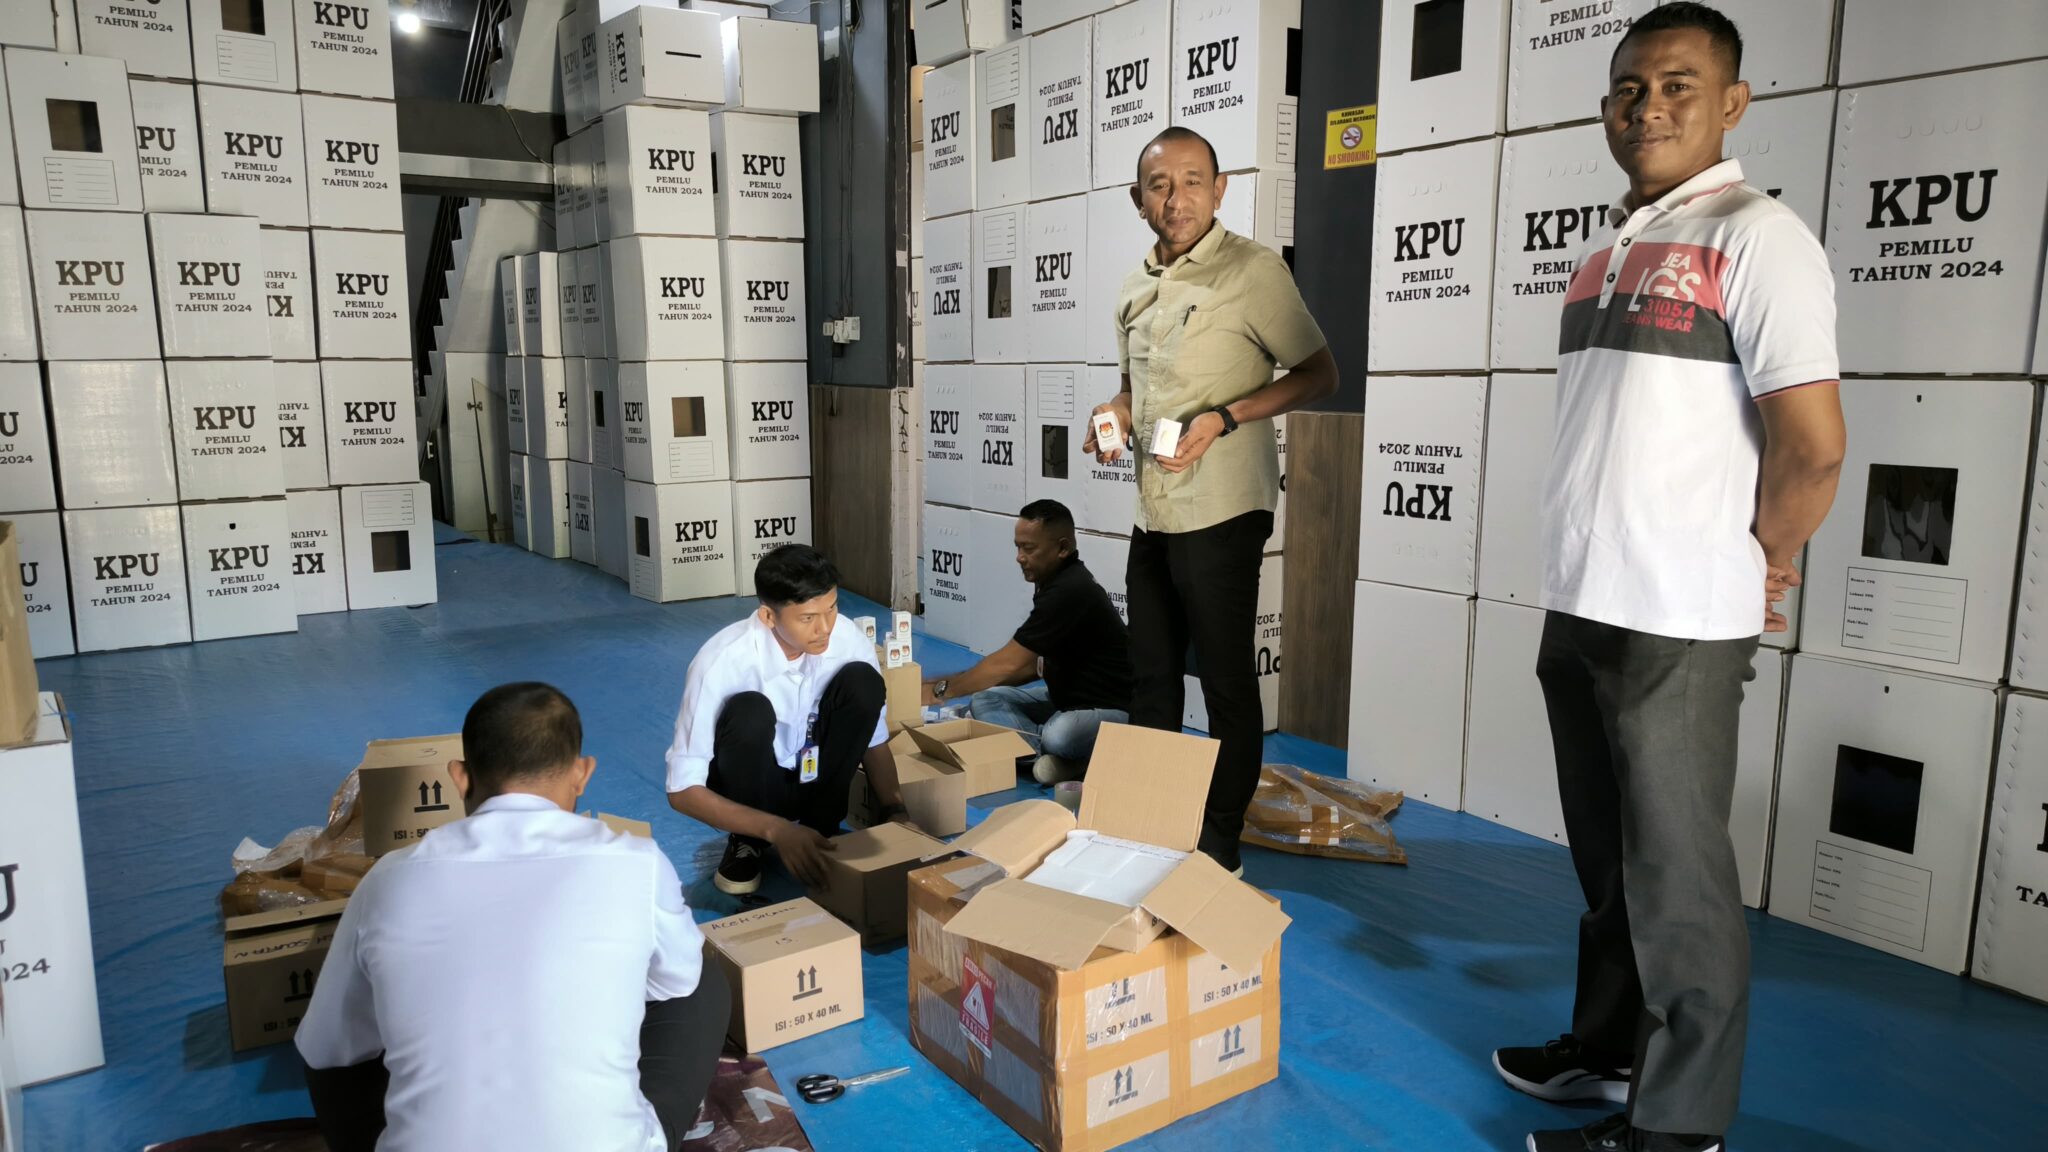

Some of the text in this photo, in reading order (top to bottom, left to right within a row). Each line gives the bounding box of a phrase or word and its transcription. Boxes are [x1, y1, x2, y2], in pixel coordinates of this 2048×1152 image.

[109, 6, 156, 19] PEMILU
[313, 1, 369, 30] KPU
[1550, 1, 1613, 26] PEMILU
[95, 16, 173, 32] TAHUN 2024
[323, 31, 363, 43] PEMILU
[1530, 16, 1633, 50] TAHUN 2024
[311, 40, 378, 55] TAHUN 2024
[614, 32, 628, 83] KPU
[1187, 36, 1239, 80] KPU
[1039, 76, 1082, 96] TAHUN 2024
[1106, 58, 1149, 99] KPU
[1193, 81, 1231, 99] PEMILU
[1047, 92, 1073, 108] PEMILU
[1111, 99, 1143, 116] PEMILU
[1182, 95, 1243, 117] TAHUN 2024
[931, 111, 960, 143] KPU
[1043, 108, 1078, 144] KPU
[1101, 112, 1154, 132] TAHUN 2024
[224, 132, 283, 159] KPU
[325, 140, 379, 165] KPU
[935, 144, 956, 157] PEMILU
[234, 162, 277, 172] PEMILU
[648, 148, 695, 172] KPU
[742, 154, 786, 177] KPU
[929, 155, 964, 171] TAHUN 2024
[1328, 154, 1337, 166] NO
[158, 168, 187, 177] 2024
[221, 171, 292, 184] TAHUN 2024
[334, 168, 374, 178] PEMILU
[656, 176, 691, 184] PEMILU
[322, 178, 388, 190] TAHUN 2024
[646, 186, 703, 195] TAHUN 2024
[749, 181, 781, 189] PEMILU
[739, 190, 792, 200] TAHUN 2024
[1866, 169, 1998, 229] KPU
[1394, 218, 1465, 262] KPU
[1879, 237, 1974, 257] PEMILU
[929, 262, 963, 274] TAHUN 2024
[1036, 252, 1072, 282] KPU
[1660, 252, 1691, 270] JEA
[55, 260, 124, 286] KPU
[177, 261, 241, 286] KPU
[1402, 268, 1454, 283] PEMILU
[1849, 260, 2004, 282] TAHUN 2024
[336, 273, 389, 296] KPU
[936, 274, 956, 285] PEMILU
[660, 277, 705, 298] KPU
[746, 281, 789, 301] KPU
[1040, 288, 1067, 299] PEMILU
[1386, 284, 1470, 302] TAHUN 2024
[1513, 280, 1568, 295] TAHUN
[69, 293, 120, 301] PEMILU
[189, 292, 235, 300] PEMILU
[933, 289, 960, 315] KPU
[54, 305, 138, 313] TAHUN 2024
[175, 304, 252, 312] TAHUN 2024
[345, 300, 384, 308] PEMILU
[1032, 300, 1076, 312] TAHUN 2024
[333, 310, 369, 318] TAHUN
[1655, 316, 1693, 332] WEAR
[193, 406, 256, 430] KPU
[344, 401, 396, 423] KPU
[624, 402, 642, 422] KPU
[752, 401, 793, 421] KPU
[978, 412, 1016, 422] TAHUN 2024
[758, 425, 789, 433] PEMILU
[930, 410, 959, 435] KPU
[986, 425, 1009, 434] PEMILU
[205, 435, 250, 444] PEMILU
[341, 437, 405, 446] TAHUN 2024
[749, 435, 777, 443] TAHUN
[934, 440, 955, 449] PEMILU
[191, 446, 266, 456] TAHUN 2024
[928, 451, 963, 461] TAHUN 2024
[982, 439, 1013, 466] KPU
[1379, 443, 1462, 458] TAHUN 2024
[1394, 461, 1445, 474] PEMILU
[1091, 470, 1120, 481] TAHUN
[1383, 481, 1453, 521] KPU
[675, 520, 718, 542] KPU
[754, 517, 796, 538] KPU
[682, 545, 713, 554] PEMILU
[208, 545, 269, 572] KPU
[672, 553, 724, 564] TAHUN 2024
[932, 549, 962, 576] KPU
[93, 553, 159, 580] KPU
[220, 574, 264, 585] PEMILU
[936, 578, 958, 590] PEMILU
[105, 583, 153, 594] PEMILU
[207, 583, 280, 597] TAHUN 2024
[929, 588, 966, 602] TAHUN 2024
[91, 593, 171, 606] TAHUN 2024
[393, 830, 407, 840] ISI
[1204, 976, 1263, 1003] ISI 50 X 40 ML
[775, 1004, 841, 1032] ISI 50 X 40 ML
[1119, 1022, 1125, 1031] X
